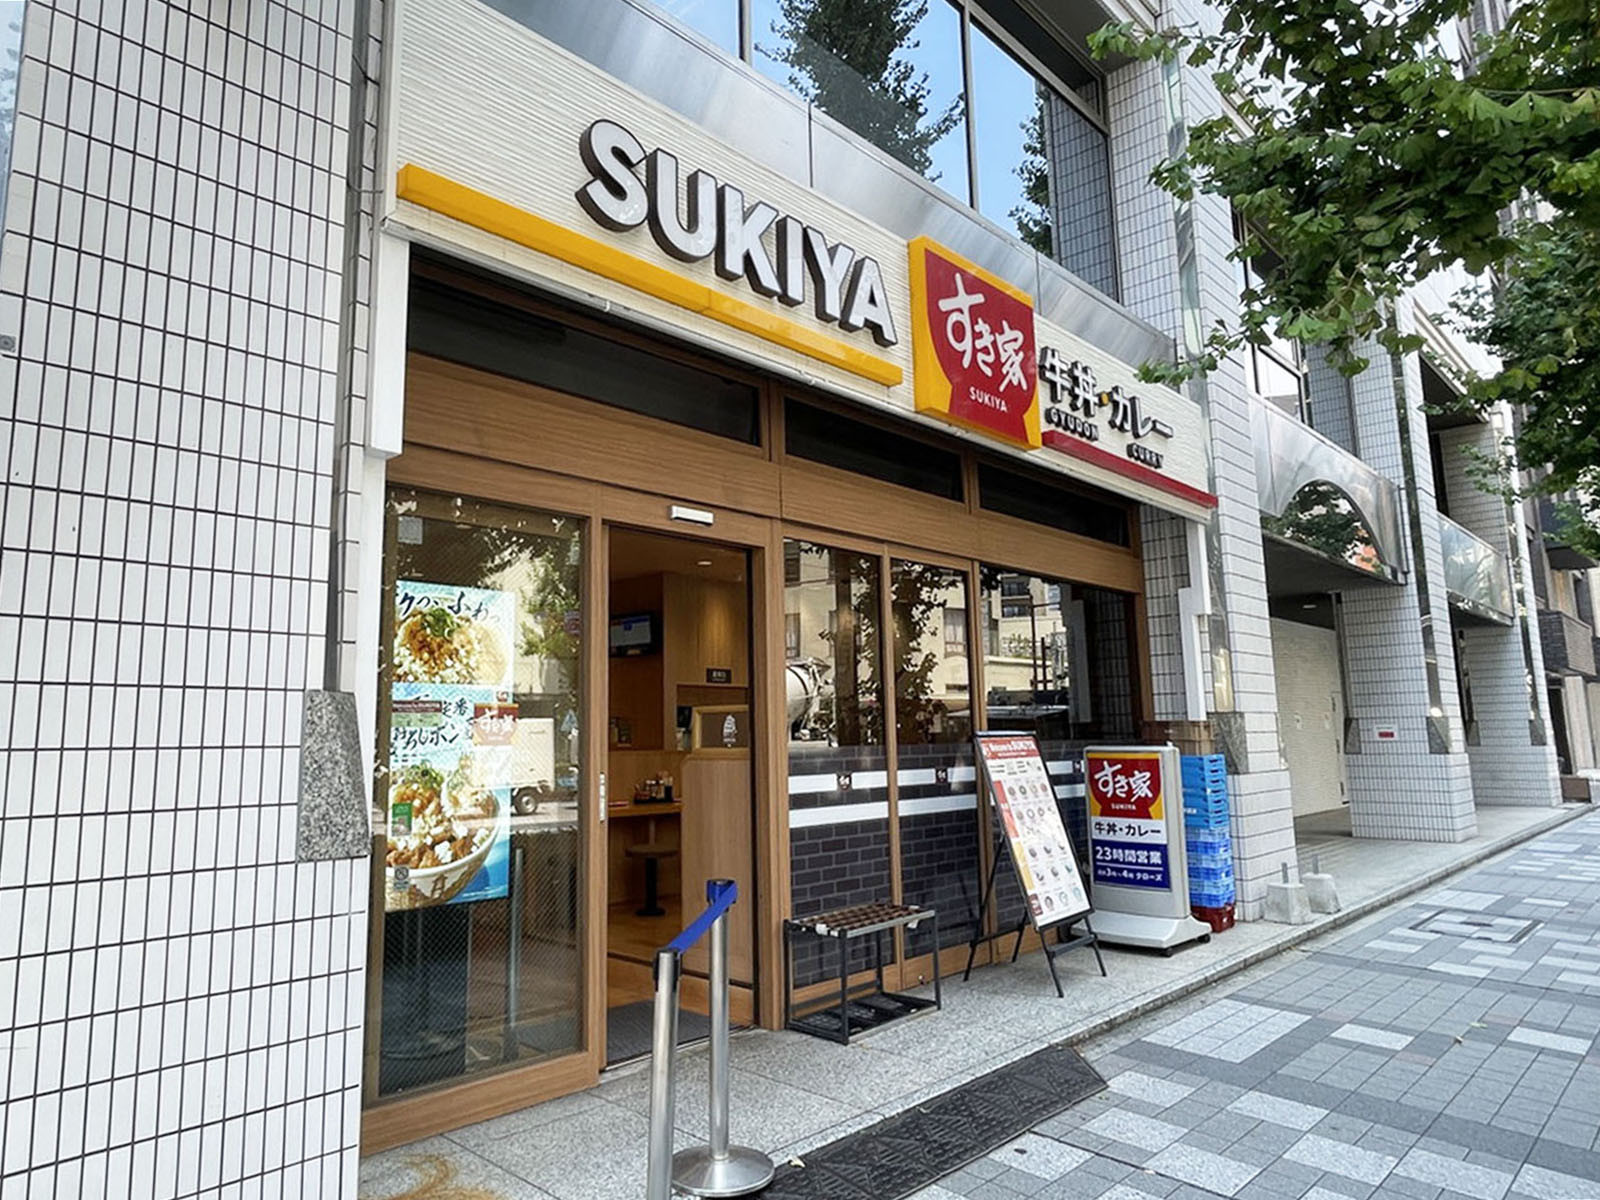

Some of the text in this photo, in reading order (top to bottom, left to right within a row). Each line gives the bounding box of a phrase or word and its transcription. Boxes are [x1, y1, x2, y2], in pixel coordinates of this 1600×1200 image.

[576, 119, 898, 347] SUKIYA
[938, 272, 1028, 392] すき家
[969, 386, 1008, 412] SUKIYA
[1040, 346, 1173, 439] 牛丼・カレー
[1045, 407, 1099, 441] GYUDON
[1126, 443, 1165, 469] CURRY
[1094, 760, 1153, 802] すき家
[1094, 821, 1161, 837] 牛丼・カレー
[1095, 846, 1162, 865] 23時間営業
